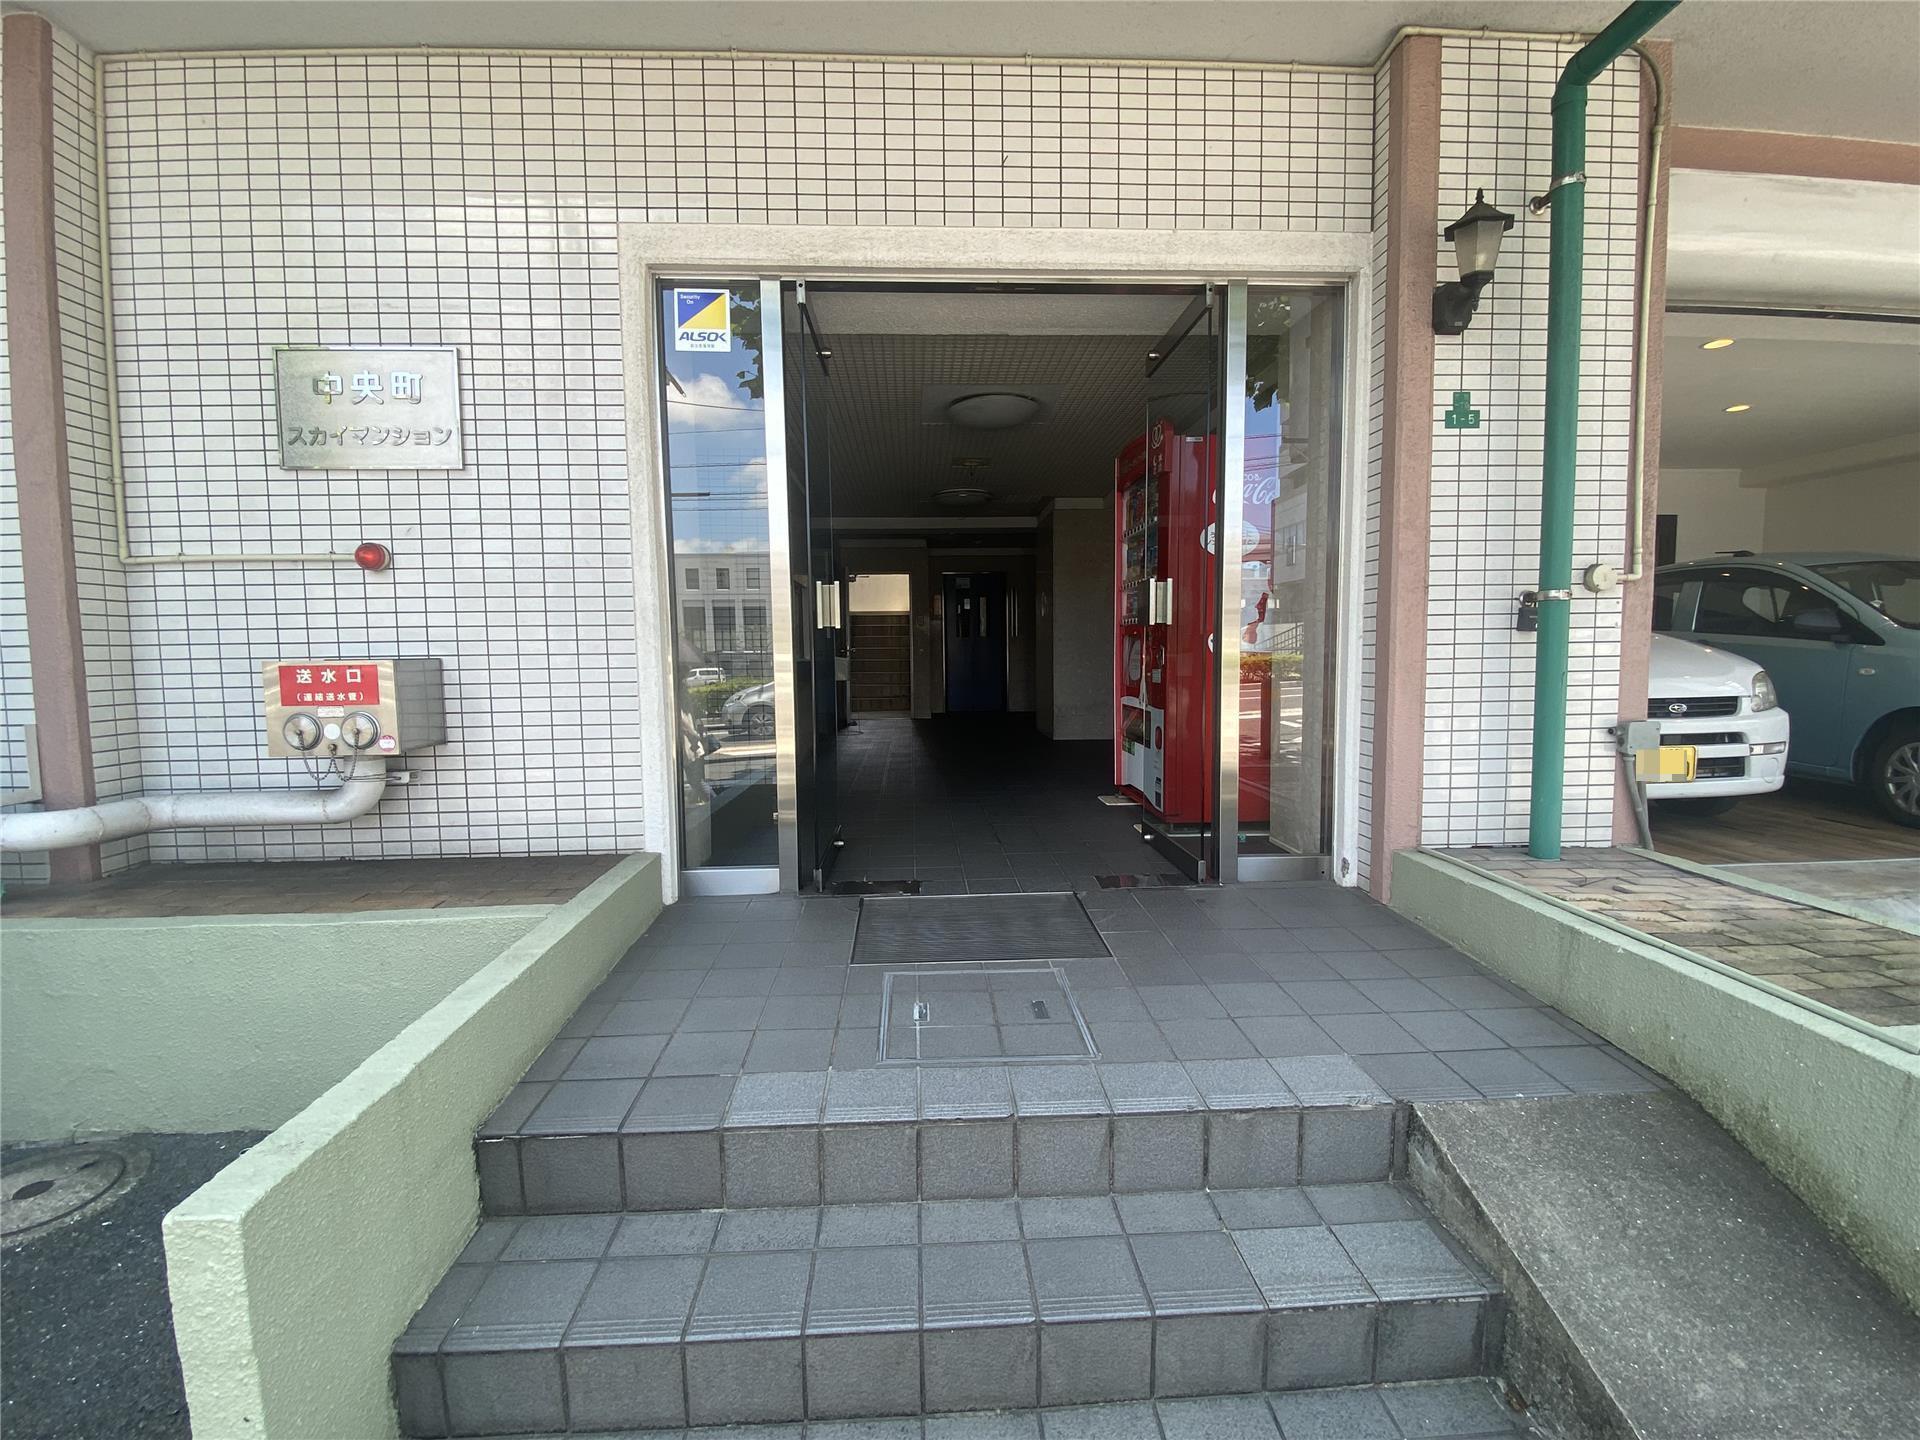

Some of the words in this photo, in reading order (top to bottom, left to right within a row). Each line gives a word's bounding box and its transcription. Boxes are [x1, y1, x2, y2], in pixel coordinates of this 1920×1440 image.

[679, 331, 727, 342] ALSOK
[313, 370, 422, 405] 中央町
[1451, 413, 1475, 425] 1-5
[287, 425, 452, 446] スカイマンション
[296, 668, 362, 684] 送水口
